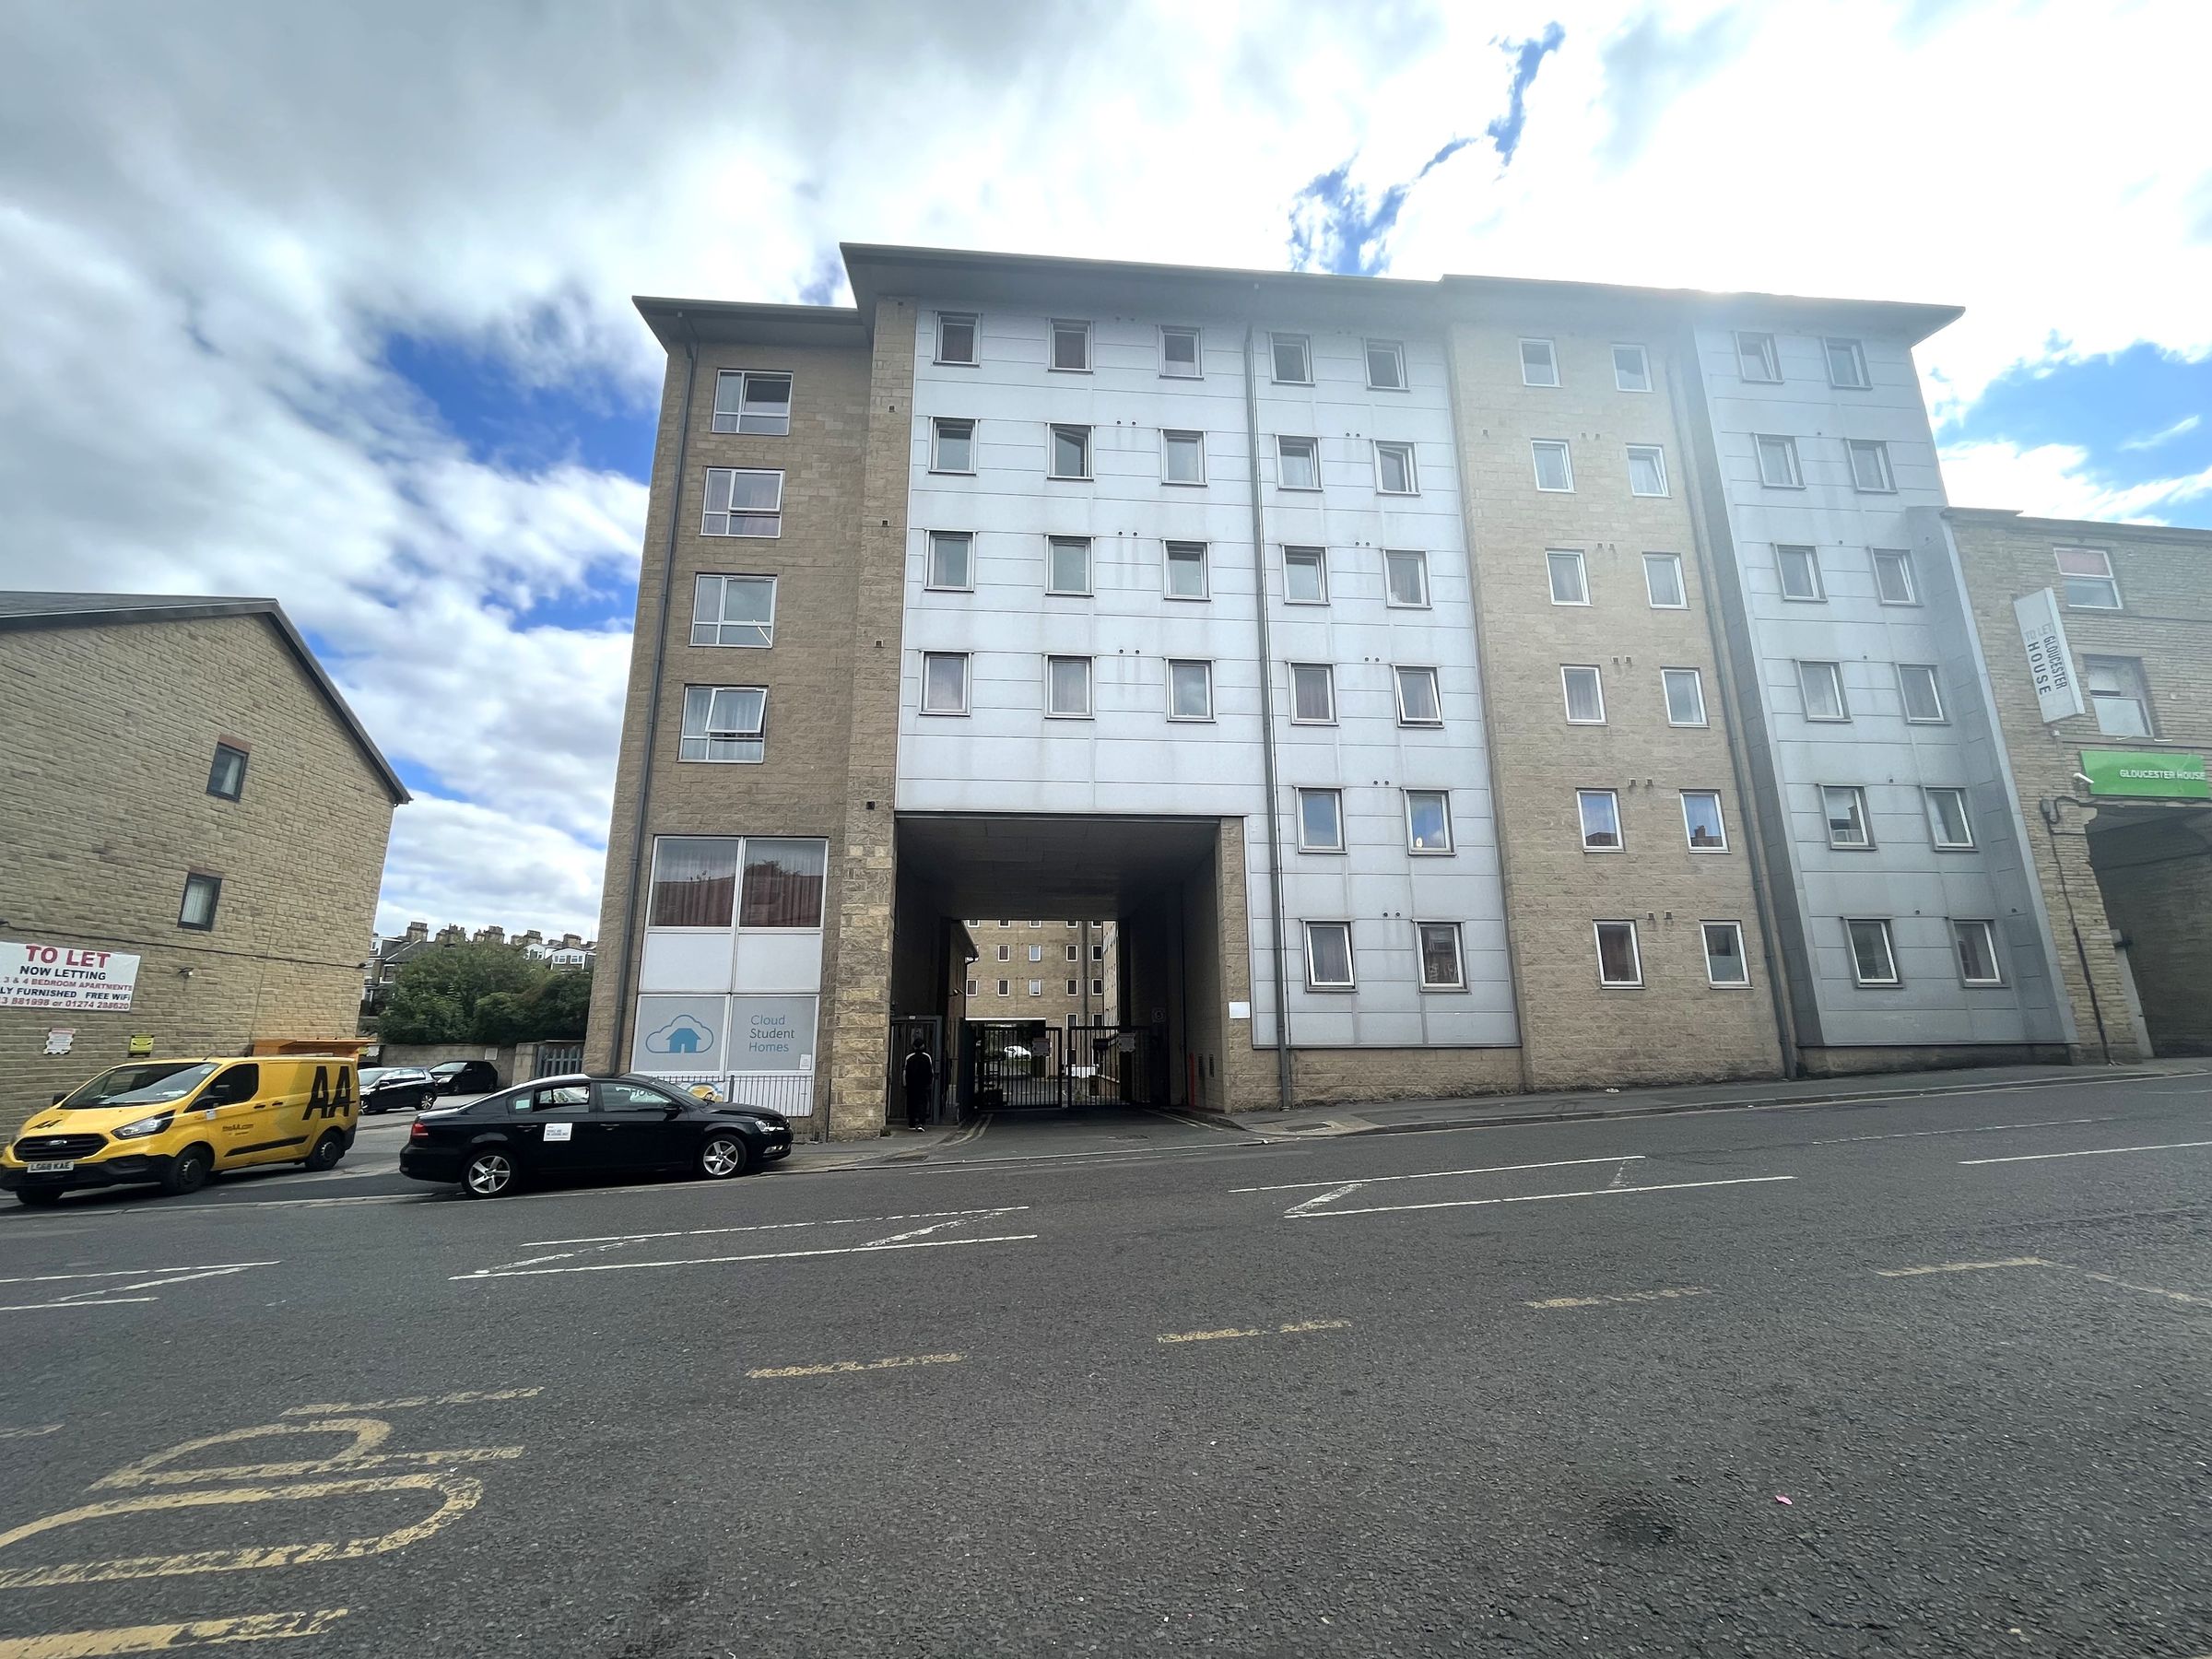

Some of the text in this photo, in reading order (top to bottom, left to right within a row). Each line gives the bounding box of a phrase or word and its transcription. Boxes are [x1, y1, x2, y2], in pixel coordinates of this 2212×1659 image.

[2028, 641, 2052, 695] HOUSE
[2043, 635, 2067, 689] GLOUCESTER
[2120, 769, 2206, 781] GLOUCESTER HOUSE
[26, 945, 111, 969] TO LET
[19, 965, 106, 980] NOW LETTING
[31, 978, 76, 987] BEDROOM
[78, 982, 133, 991] APARTMENTS
[17, 987, 77, 998] FURNISHED
[86, 992, 109, 1000] FREE
[65, 1000, 94, 1008] 01274
[750, 1014, 785, 1026] Cloud
[749, 1028, 795, 1039] Student
[748, 1041, 790, 1053] Homes
[302, 1065, 351, 1121] AA
